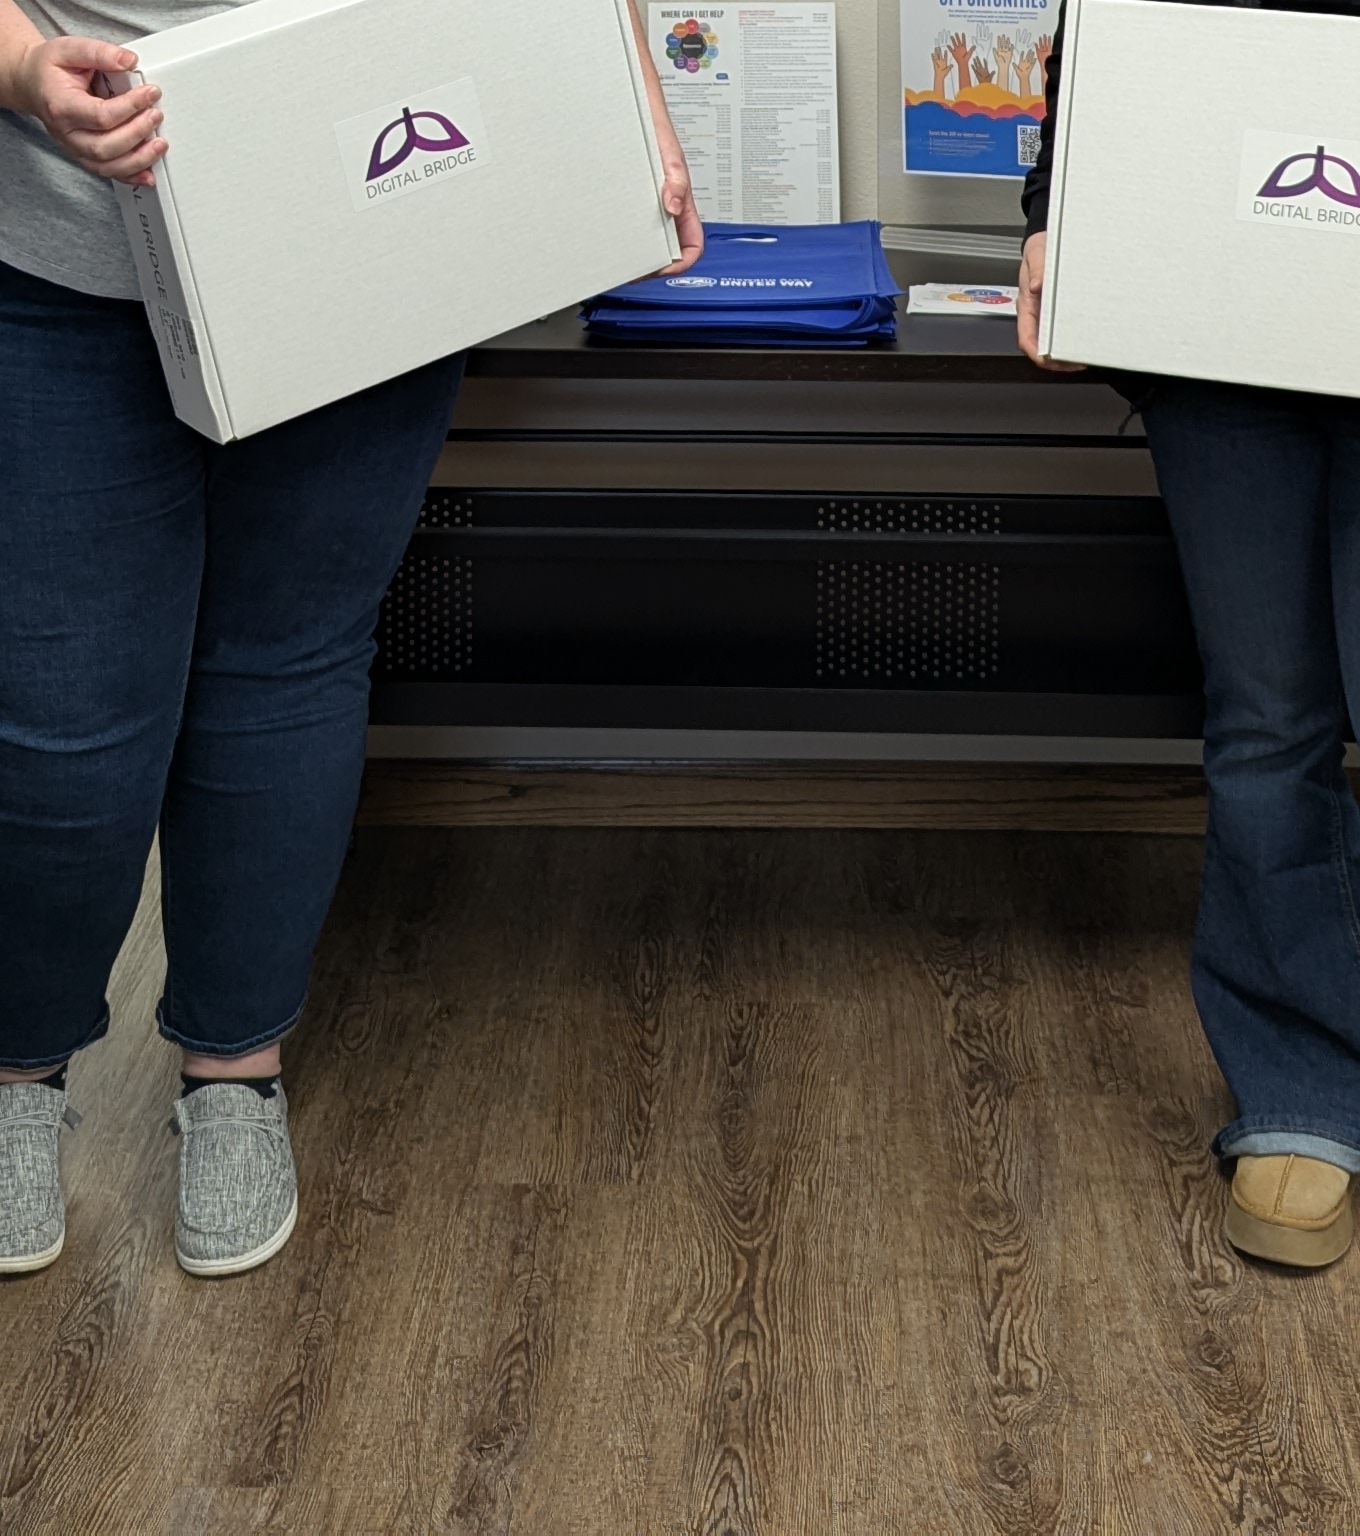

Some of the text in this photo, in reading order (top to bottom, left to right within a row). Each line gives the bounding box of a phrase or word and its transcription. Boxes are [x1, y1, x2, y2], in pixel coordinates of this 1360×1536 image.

[661, 10, 681, 18] WHERE
[682, 10, 694, 18] CAN
[699, 10, 709, 18] GET
[710, 10, 724, 18] HELP
[366, 147, 477, 199] DIGITAL BRIDGE
[1252, 200, 1313, 221] DIGITAL
[139, 213, 169, 301] BRIDGE
[719, 278, 813, 287] UNITED WAY
